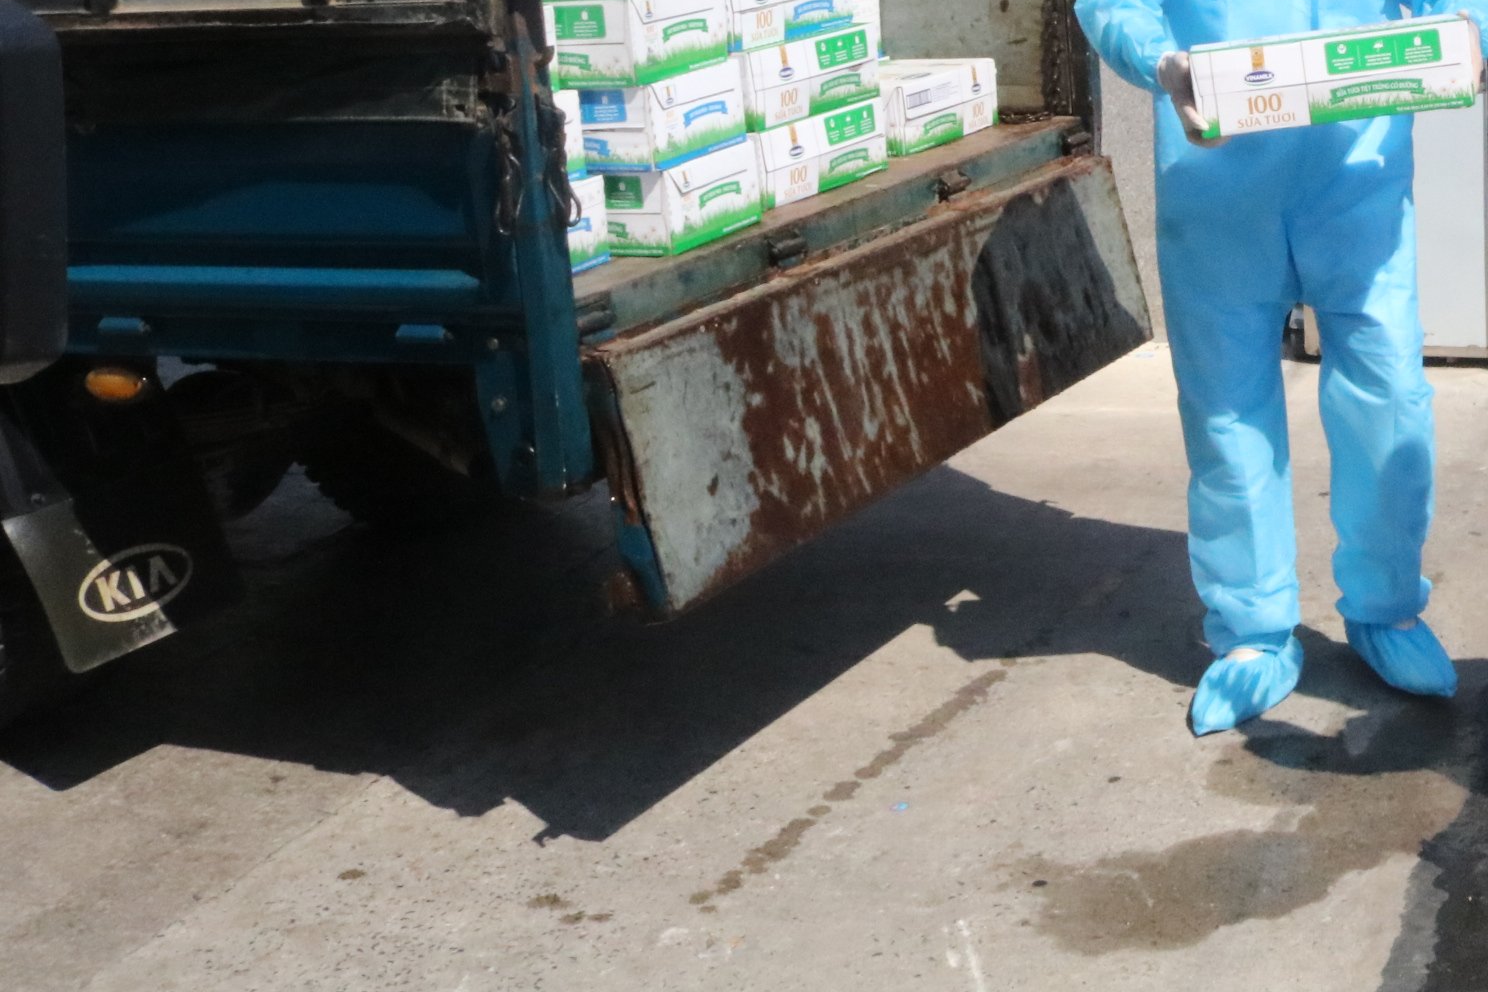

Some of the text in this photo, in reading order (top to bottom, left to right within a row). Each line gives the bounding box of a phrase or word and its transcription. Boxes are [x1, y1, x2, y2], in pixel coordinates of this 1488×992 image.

[756, 10, 773, 30] 100
[780, 88, 798, 108] 100
[1247, 93, 1282, 115] 100
[790, 165, 807, 186] 100
[95, 554, 177, 612] KIA
